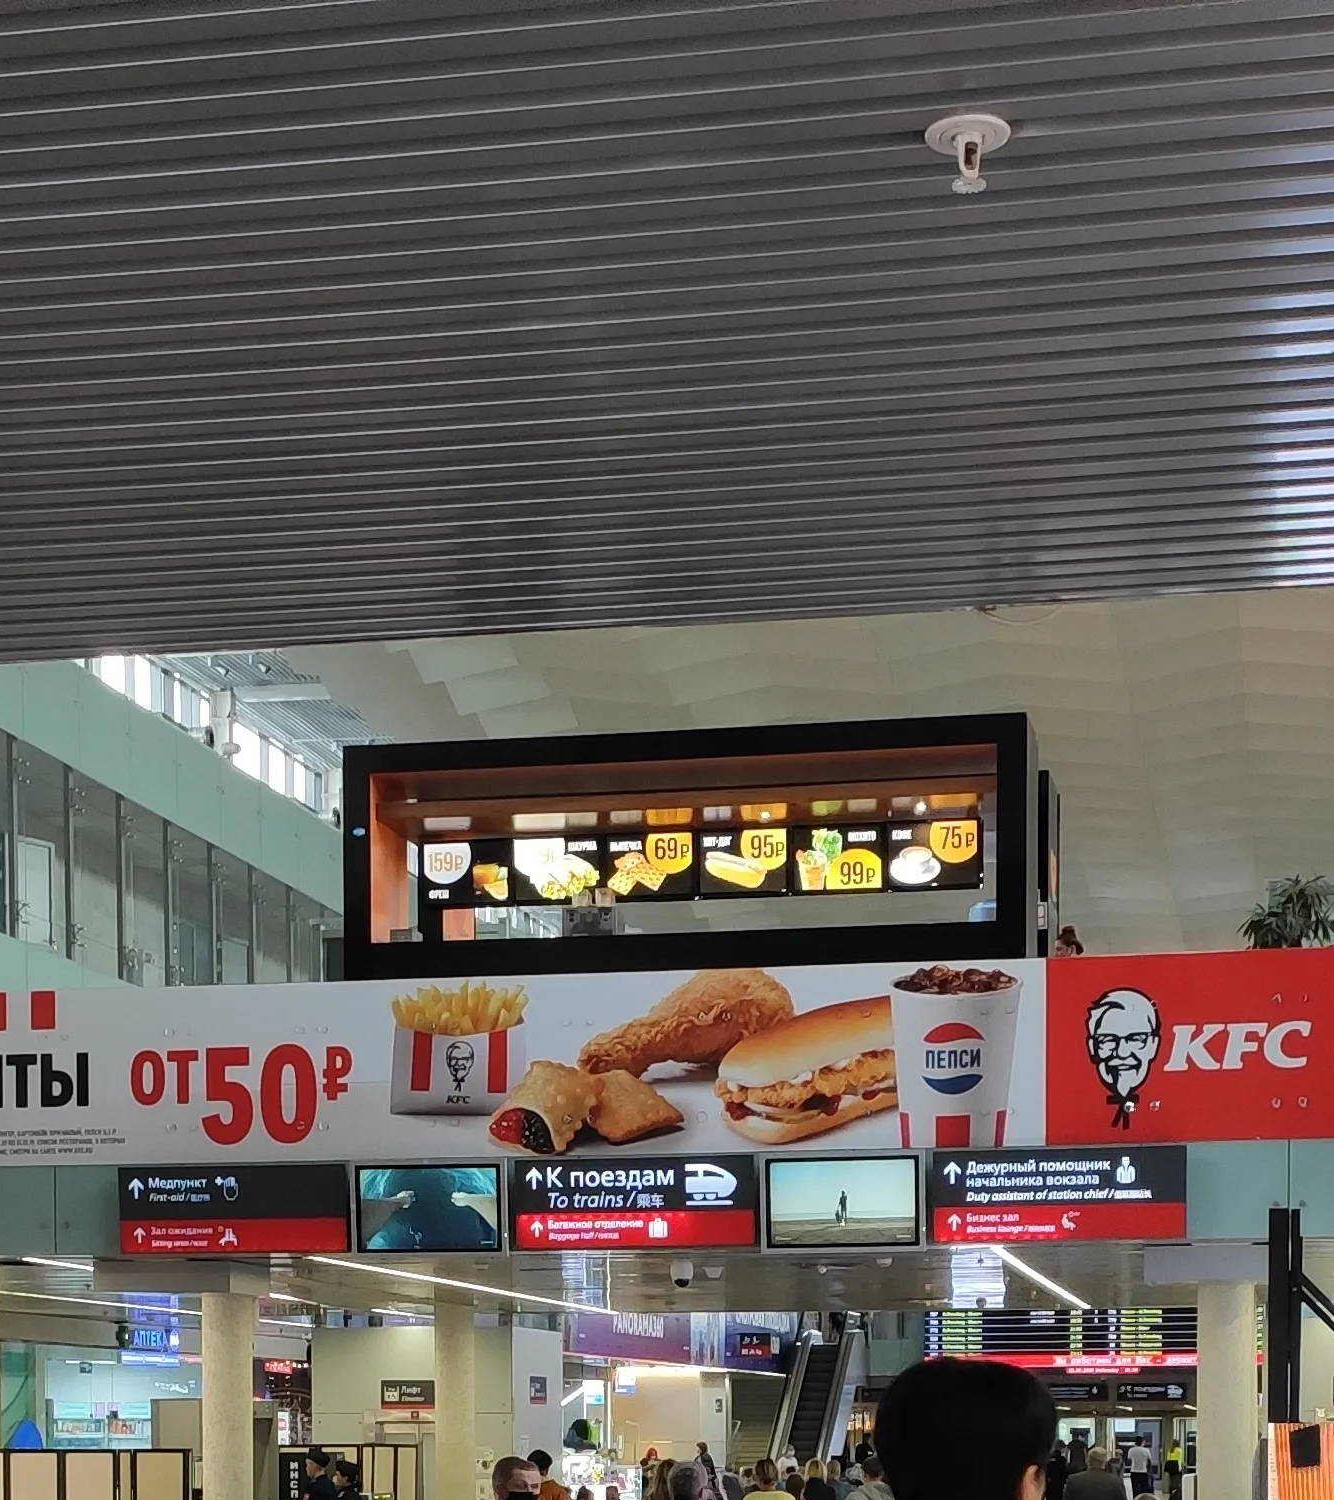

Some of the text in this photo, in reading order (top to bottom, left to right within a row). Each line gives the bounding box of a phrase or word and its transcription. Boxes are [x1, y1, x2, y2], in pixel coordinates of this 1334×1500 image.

[1164, 1021, 1312, 1072] KFC
[925, 1047, 982, 1070] ПЕПСИ
[445, 1094, 471, 1105] KFC
[966, 1160, 1111, 1176] Дежурный помощник
[148, 1177, 208, 1191] Медпункт
[546, 1166, 675, 1190] К поездам
[966, 1173, 1100, 1188] начальника вокзала
[149, 1193, 186, 1202] First-aid
[548, 1192, 568, 1209] To
[573, 1191, 624, 1208] trains
[966, 1191, 989, 1204] Duty
[991, 1189, 1035, 1202] assistant
[1036, 1189, 1047, 1201] of
[1048, 1188, 1083, 1201] station
[547, 1219, 644, 1231] Багажное отделение
[966, 1213, 1020, 1223] Бизнес зал
[150, 1226, 214, 1236] Зал ожидания
[133, 1330, 168, 1347] АПТЕКА
